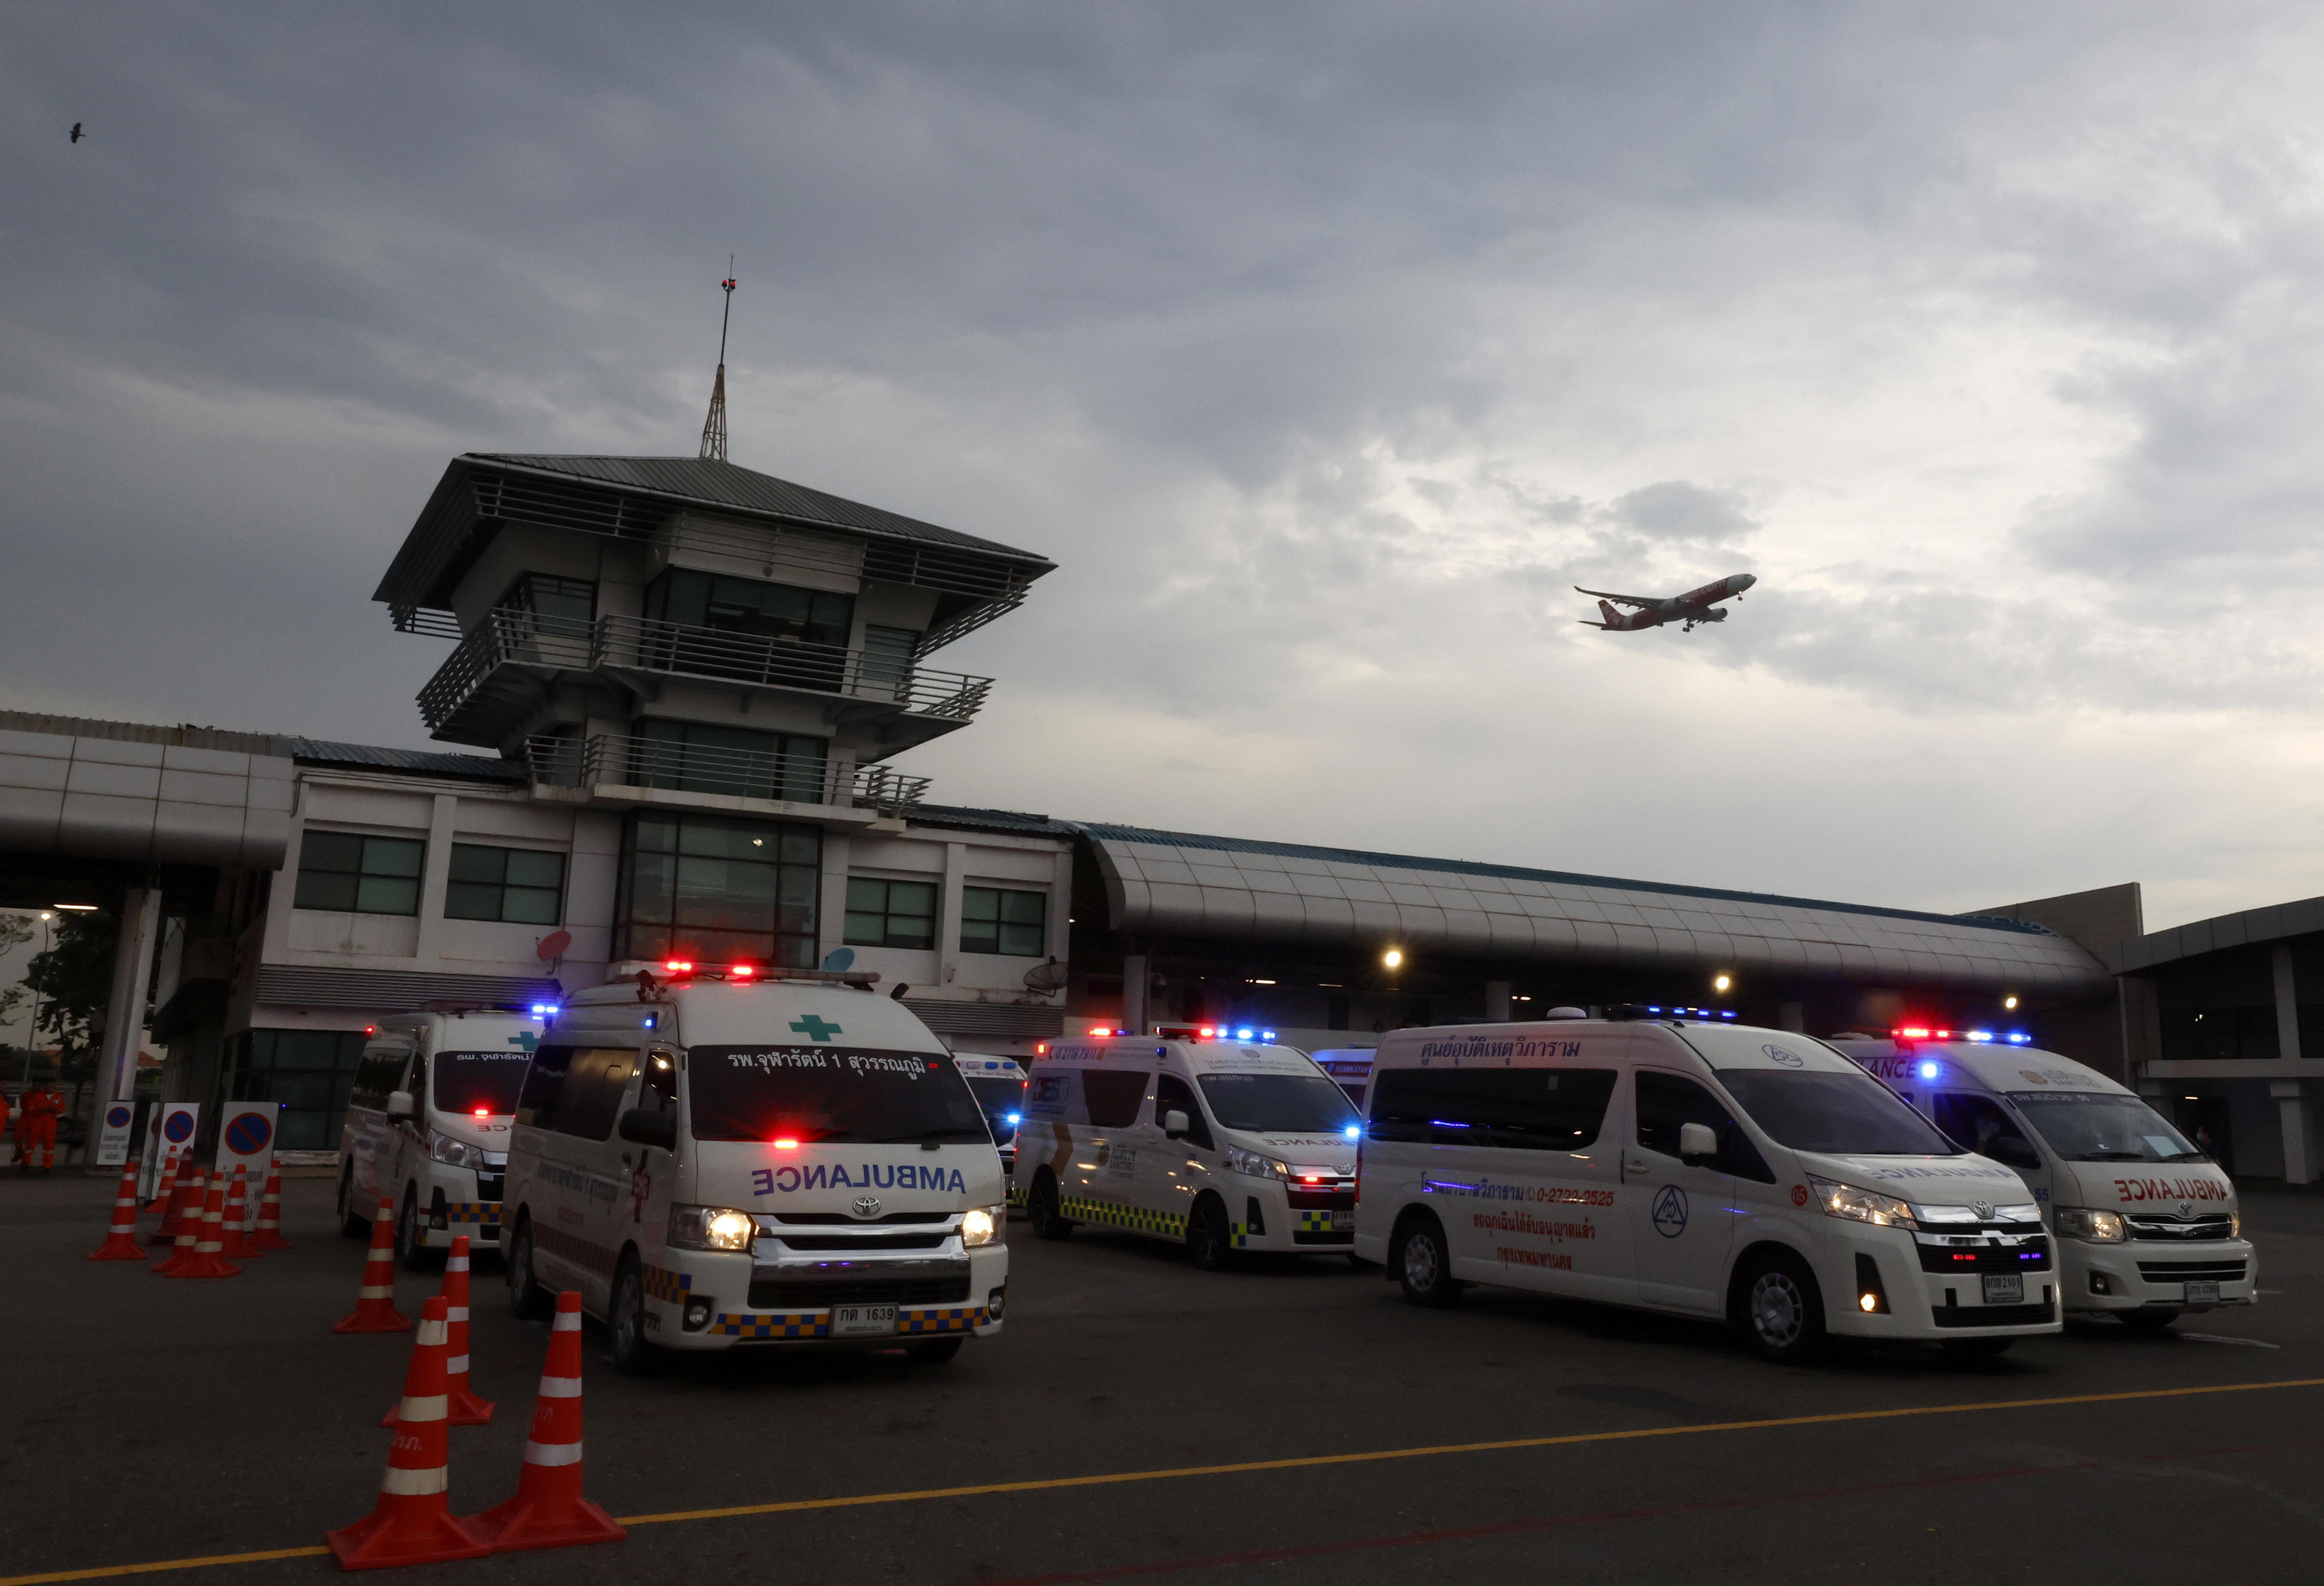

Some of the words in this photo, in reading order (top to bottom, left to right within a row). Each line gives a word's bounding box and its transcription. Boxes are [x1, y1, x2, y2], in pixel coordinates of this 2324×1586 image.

[832, 1054, 841, 1068] 1
[847, 1056, 926, 1080] สุวรรณภูมิ
[1792, 1188, 1806, 1203] 05
[2035, 1188, 2049, 1202] 55
[866, 1308, 893, 1321] 1639
